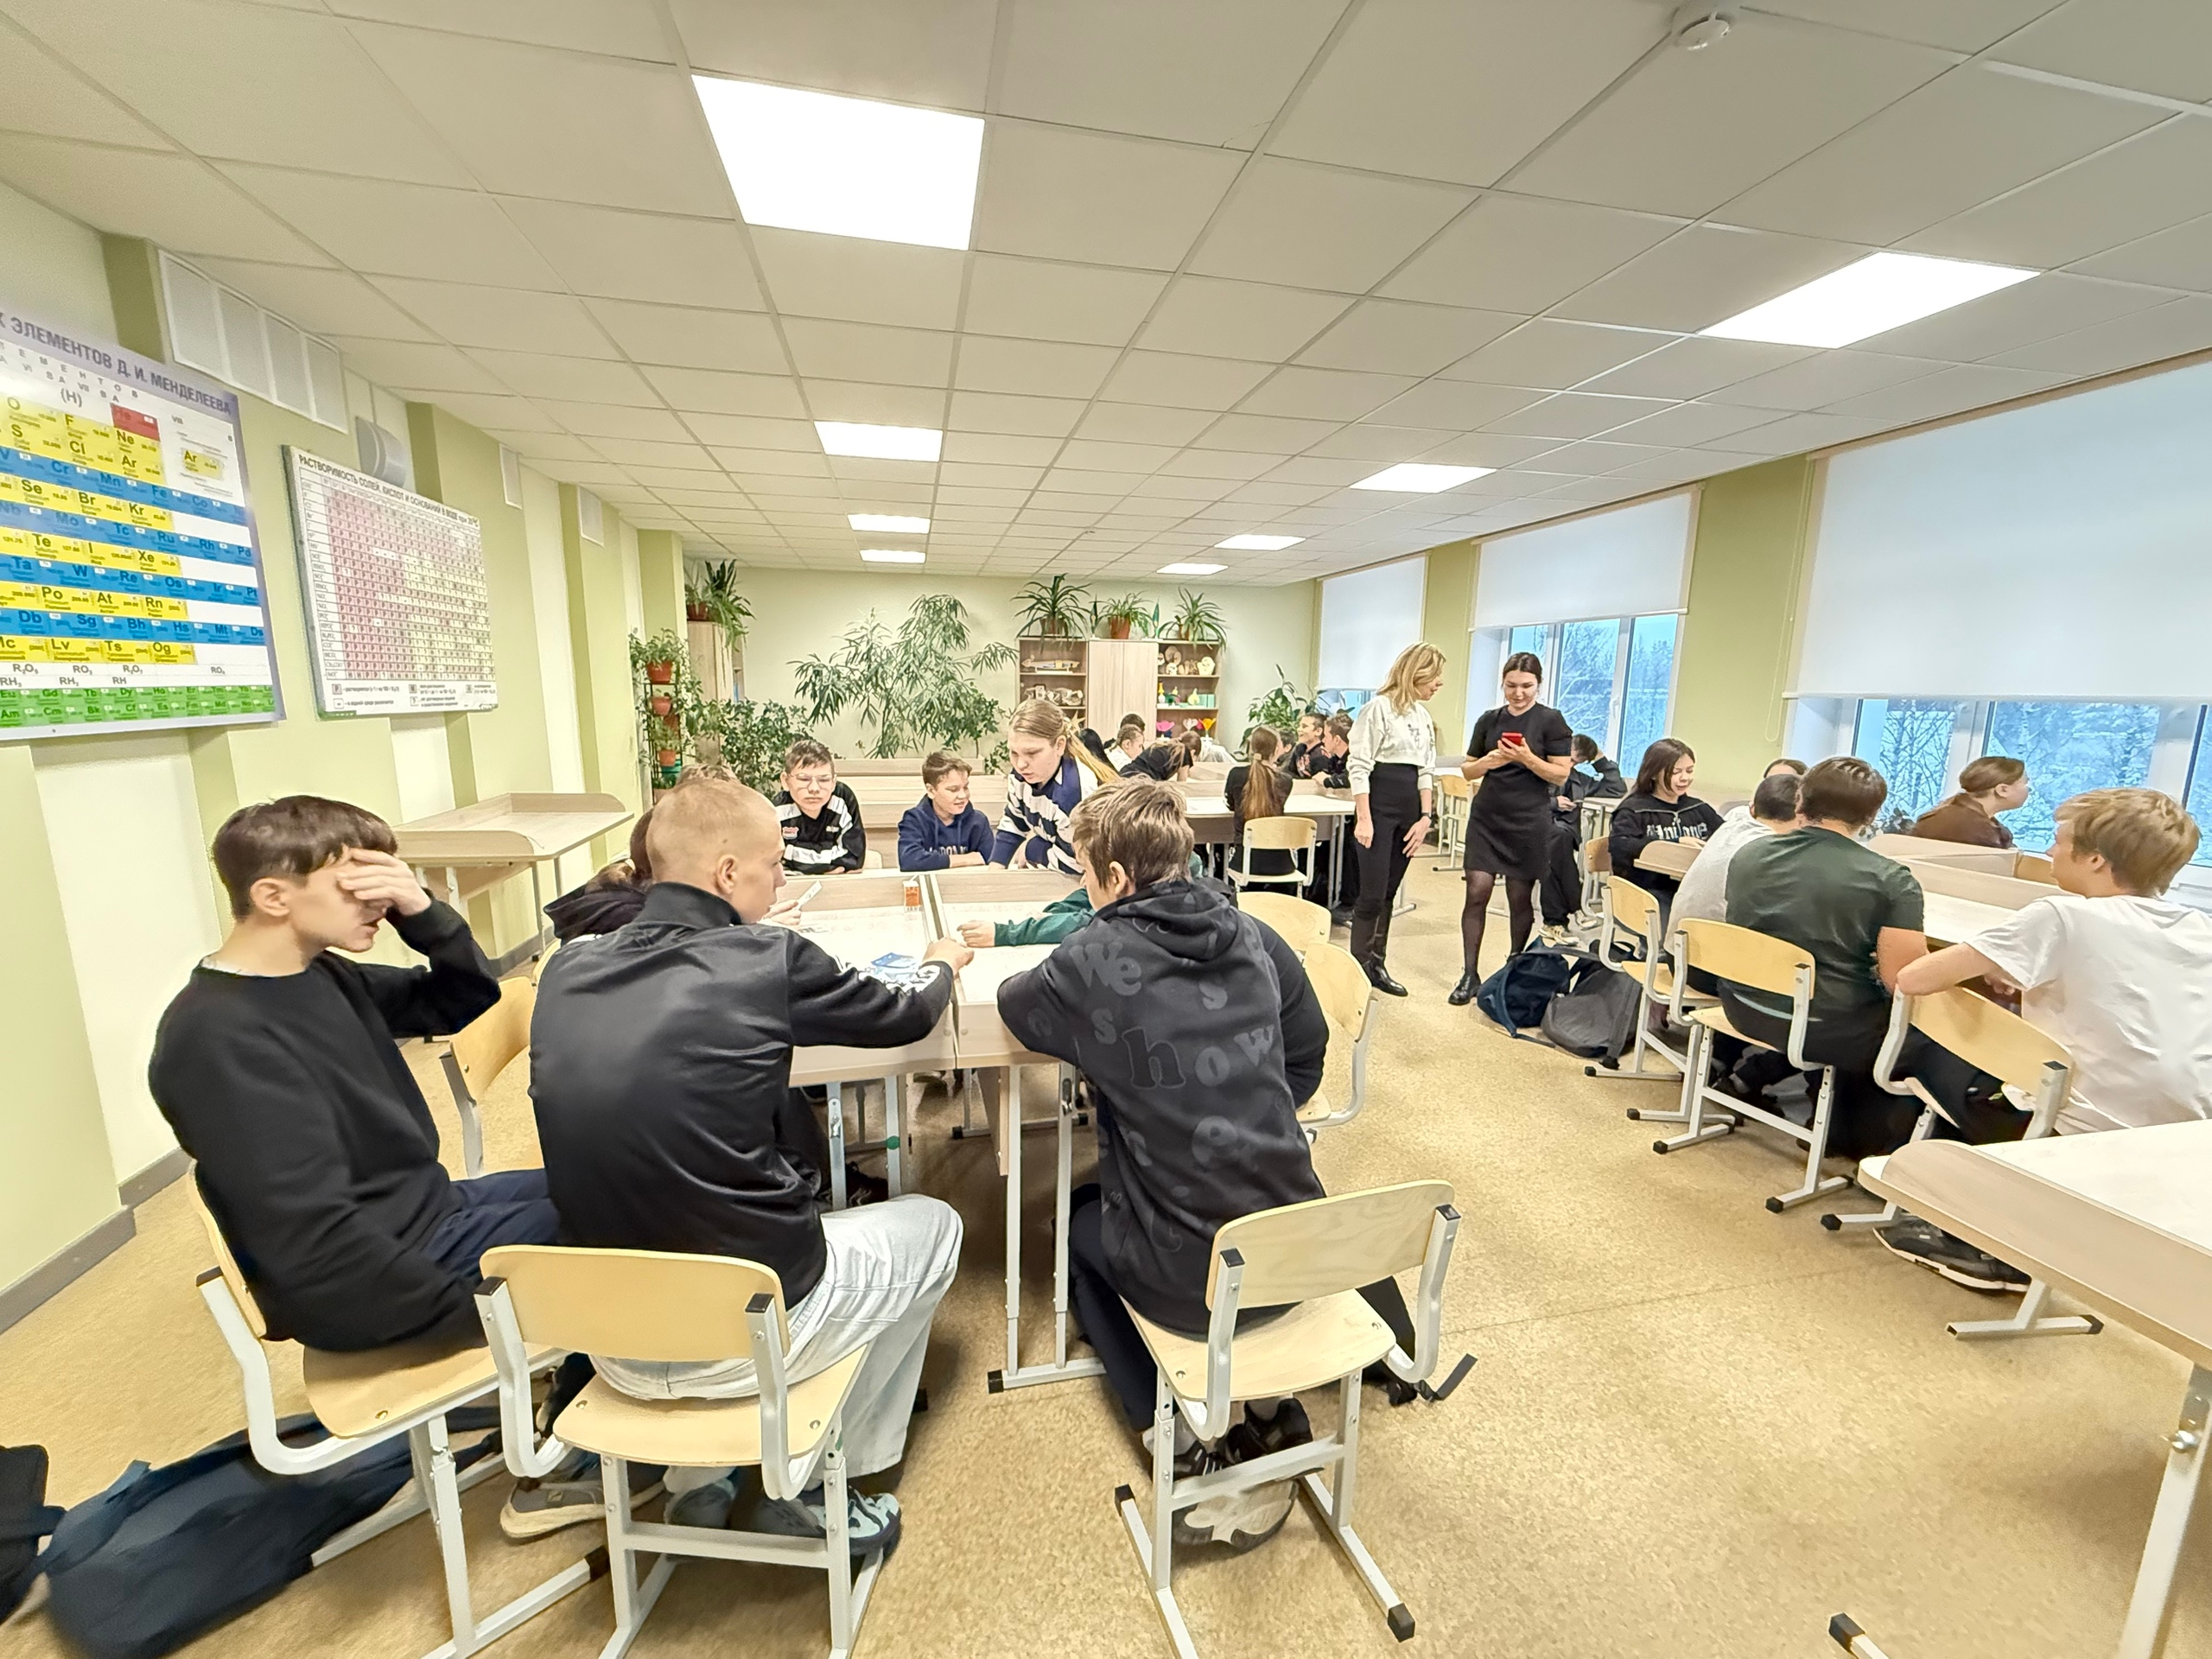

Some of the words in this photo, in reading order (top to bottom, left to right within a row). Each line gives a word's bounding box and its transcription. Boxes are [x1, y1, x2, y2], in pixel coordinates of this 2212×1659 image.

[10, 316, 112, 369] ЭЛЕМЕНТОВ
[118, 359, 131, 378] Д.
[134, 365, 147, 383] И.
[150, 372, 232, 416] МЕНДЕЛЕЕВА
[60, 388, 82, 408] (H)
[65, 414, 73, 426] F
[117, 430, 135, 445] Ne
[11, 424, 22, 437] S
[69, 441, 86, 455] Cl
[122, 454, 137, 467] Ar
[184, 450, 197, 462] Ar
[21, 480, 42, 494] Se
[79, 492, 96, 505] Br
[129, 503, 143, 516] Kr
[52, 461, 69, 474] Cr
[99, 473, 121, 486] Mn
[152, 486, 168, 499] Fe
[192, 496, 207, 508] Co
[299, 454, 358, 484] РАСТВОРИМОСТЬ
[410, 496, 441, 513] ОСНОВАНИЙ
[32, 533, 51, 547] Te
[138, 550, 155, 563] Xe
[55, 512, 79, 526] Mo
[113, 522, 130, 535] Tc
[157, 531, 175, 543] Ru
[200, 539, 215, 550] Rh
[238, 546, 251, 557] Pd
[12, 556, 32, 569] Ta
[72, 564, 87, 577] W
[119, 570, 137, 583] Re
[165, 576, 182, 588] Os
[246, 587, 257, 597] Pt
[41, 586, 63, 600] Po
[97, 592, 112, 604] At
[145, 596, 163, 608] Rn
[18, 610, 42, 623] Db
[76, 613, 97, 627] Sg
[127, 618, 145, 629] Bh
[174, 621, 189, 632] Hs
[215, 624, 227, 634] Mt
[251, 626, 264, 636] Ds
[51, 639, 70, 650] Lv
[105, 640, 122, 652] Ts
[153, 642, 171, 654] Og
[42, 689, 58, 697] Gd
[120, 688, 132, 696] Dy
[1, 709, 20, 719] Am
[43, 707, 61, 715] Cm
[125, 703, 137, 712] Cf
[1069, 942, 1142, 996] We
